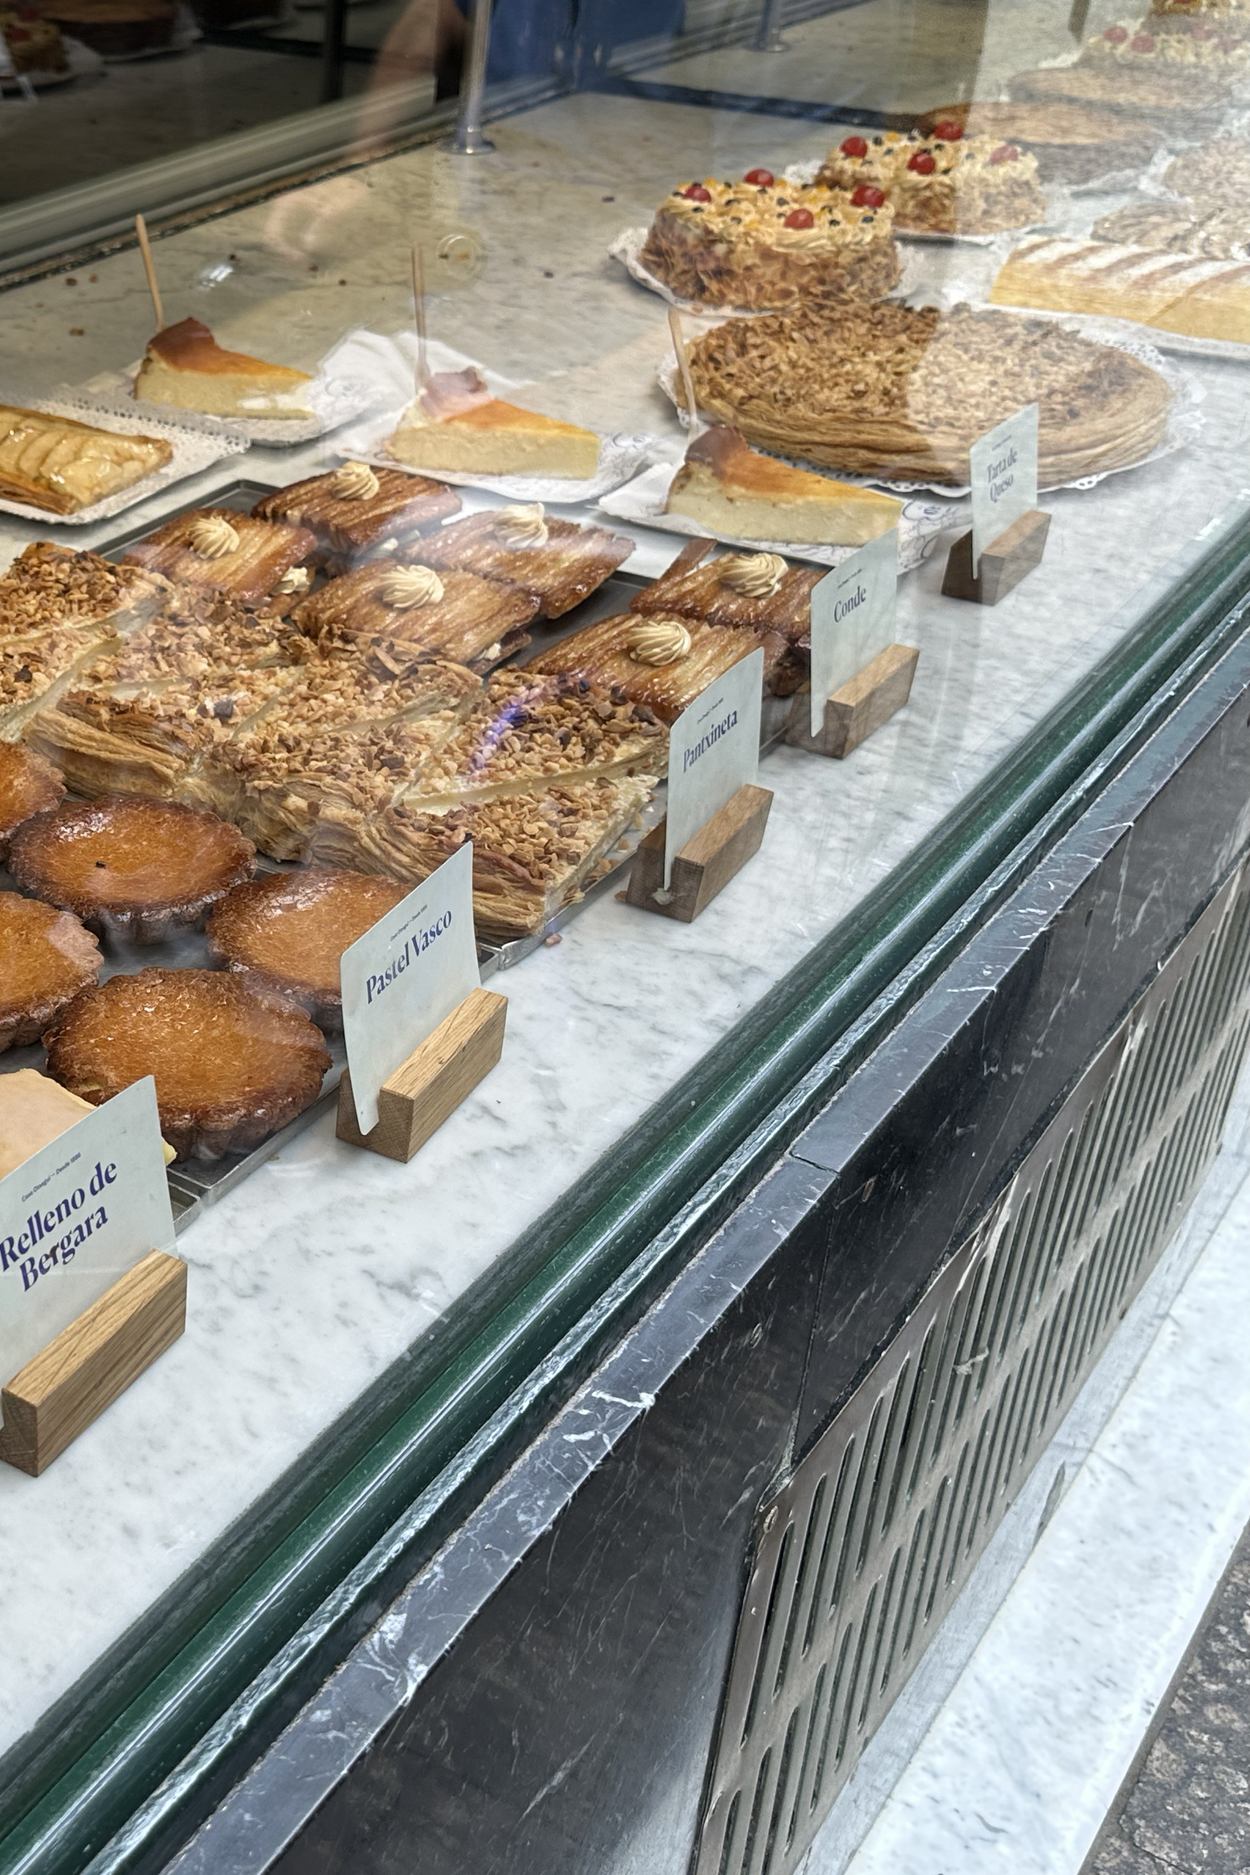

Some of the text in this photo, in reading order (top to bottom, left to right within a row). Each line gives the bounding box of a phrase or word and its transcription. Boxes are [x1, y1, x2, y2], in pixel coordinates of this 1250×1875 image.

[833, 585, 867, 623] Conde
[683, 710, 738, 773] Pantxineta
[366, 942, 410, 1005] Pastel
[411, 910, 452, 957] Vasco
[89, 1161, 118, 1196] de
[19, 1206, 109, 1292] Bergara
